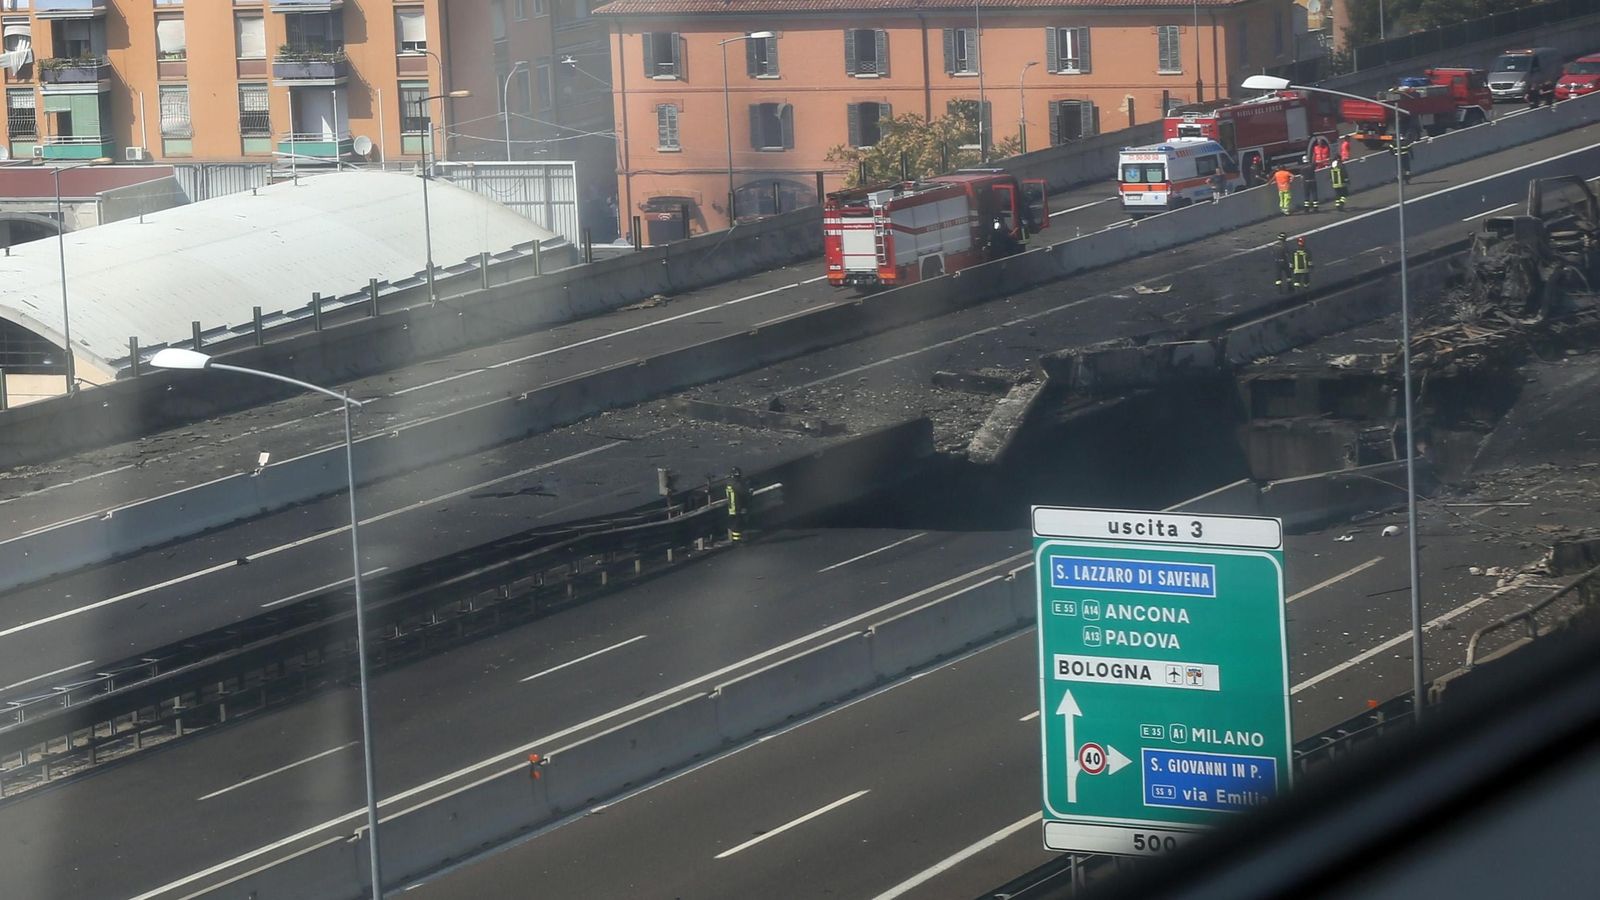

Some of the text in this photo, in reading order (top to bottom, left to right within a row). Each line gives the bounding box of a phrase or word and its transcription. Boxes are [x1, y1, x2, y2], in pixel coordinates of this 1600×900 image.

[1108, 518, 1203, 538] uscita 3
[1056, 564, 1210, 588] S. LAZZARO DI SAVENA
[1055, 603, 1190, 624] E 55 A14 ANCONA
[1085, 629, 1181, 649] A13 PADOVA
[1059, 659, 1152, 681] BOLOGNA
[1143, 727, 1264, 747] E 35 A1 MILANO
[1084, 752, 1100, 766] 40
[1151, 757, 1262, 779] S. GIOVANNI IN P.
[1155, 787, 1164, 797] SS
[1167, 788, 1173, 797] 9
[1183, 787, 1208, 802] via
[1133, 833, 1177, 853] 500
